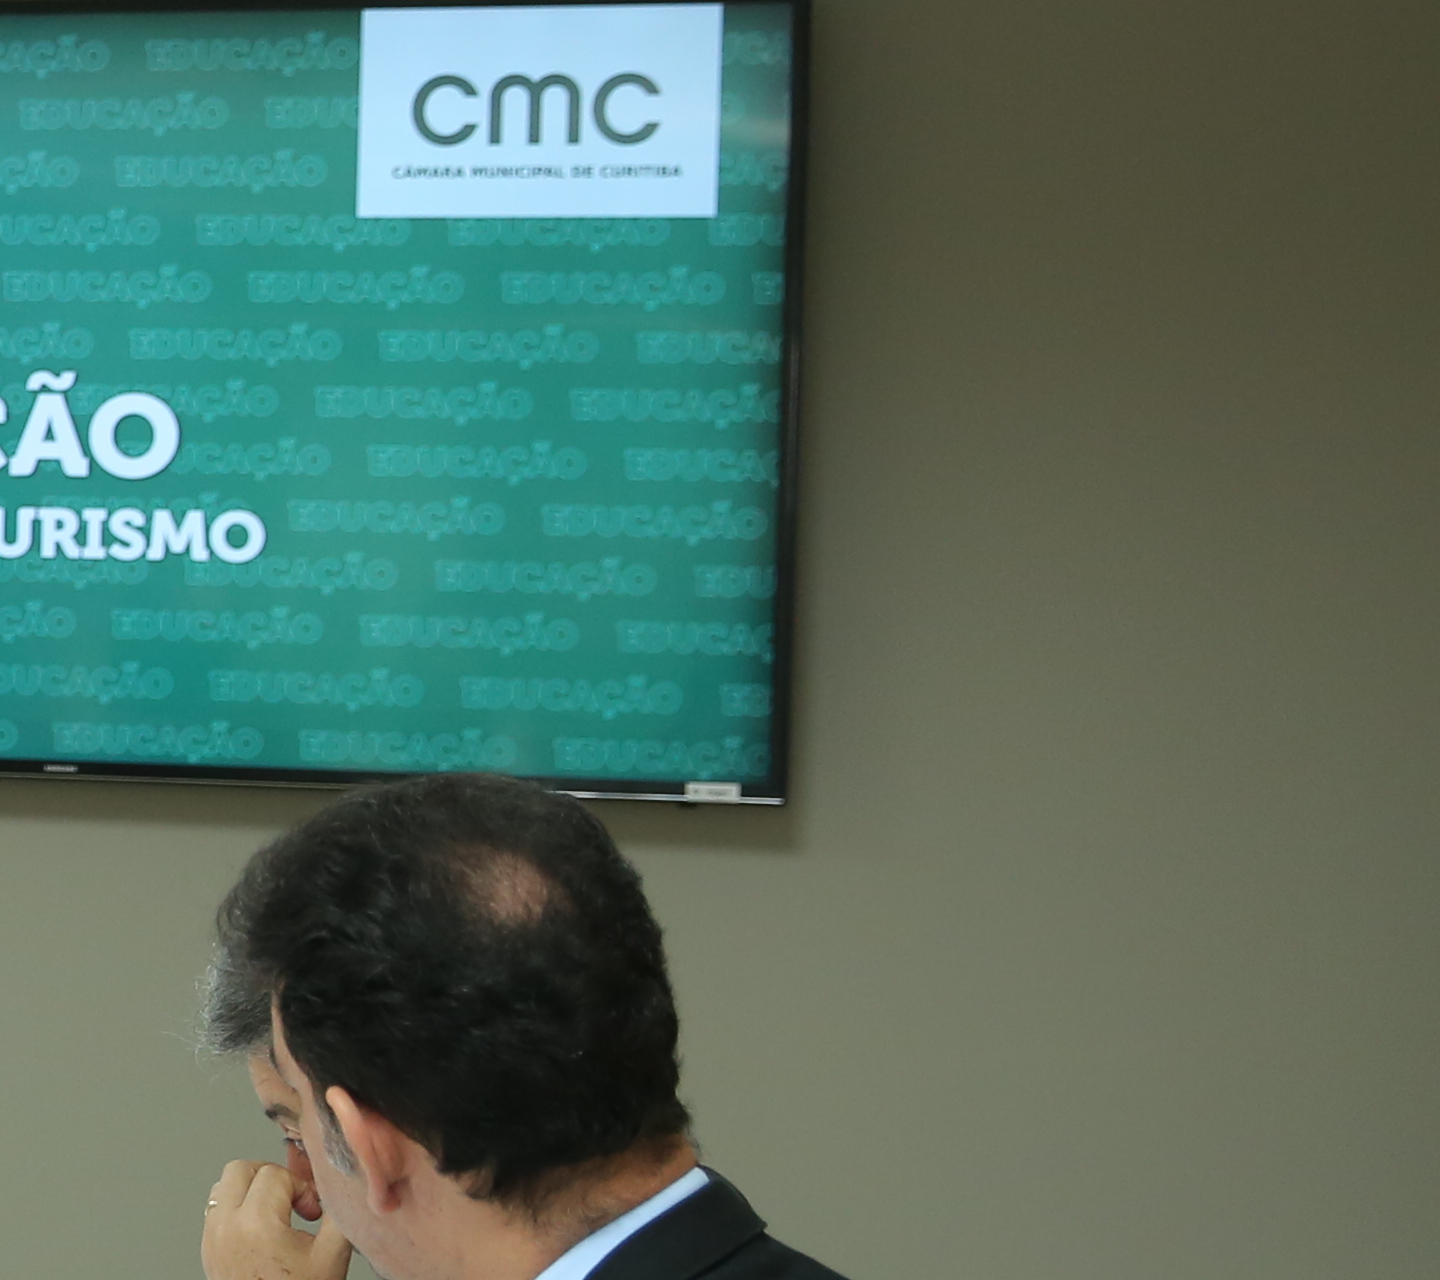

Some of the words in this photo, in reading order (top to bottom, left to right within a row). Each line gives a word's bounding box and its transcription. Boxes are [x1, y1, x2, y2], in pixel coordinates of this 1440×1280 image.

[18, 90, 229, 136] EDUCAÇÃO
[413, 74, 661, 146] cmc
[114, 147, 326, 194] EDUCAÇÃO
[391, 164, 466, 179] CÂMARA
[469, 166, 564, 179] MUNICIPAL
[570, 166, 593, 179] DE
[599, 165, 683, 179] CURITIBA
[2, 265, 212, 311] EDUCAÇÃO
[247, 265, 464, 311] EDUCAÇÃO
[501, 264, 726, 310] EDUCAÇÃO
[129, 321, 343, 368] EDUCAÇÃO
[378, 321, 599, 370] EDUCAÇÃO
[366, 440, 586, 485] EDUCAÇÃO
[287, 497, 505, 542] EDUCAÇÃO
[540, 499, 769, 546] EDUCAÇÃO
[111, 607, 323, 649] EDUCAÇÃO
[210, 666, 425, 712] EDUCAÇÃO
[460, 675, 681, 719] EDUCAÇÃO
[53, 721, 264, 764] EDUCAÇÃO
